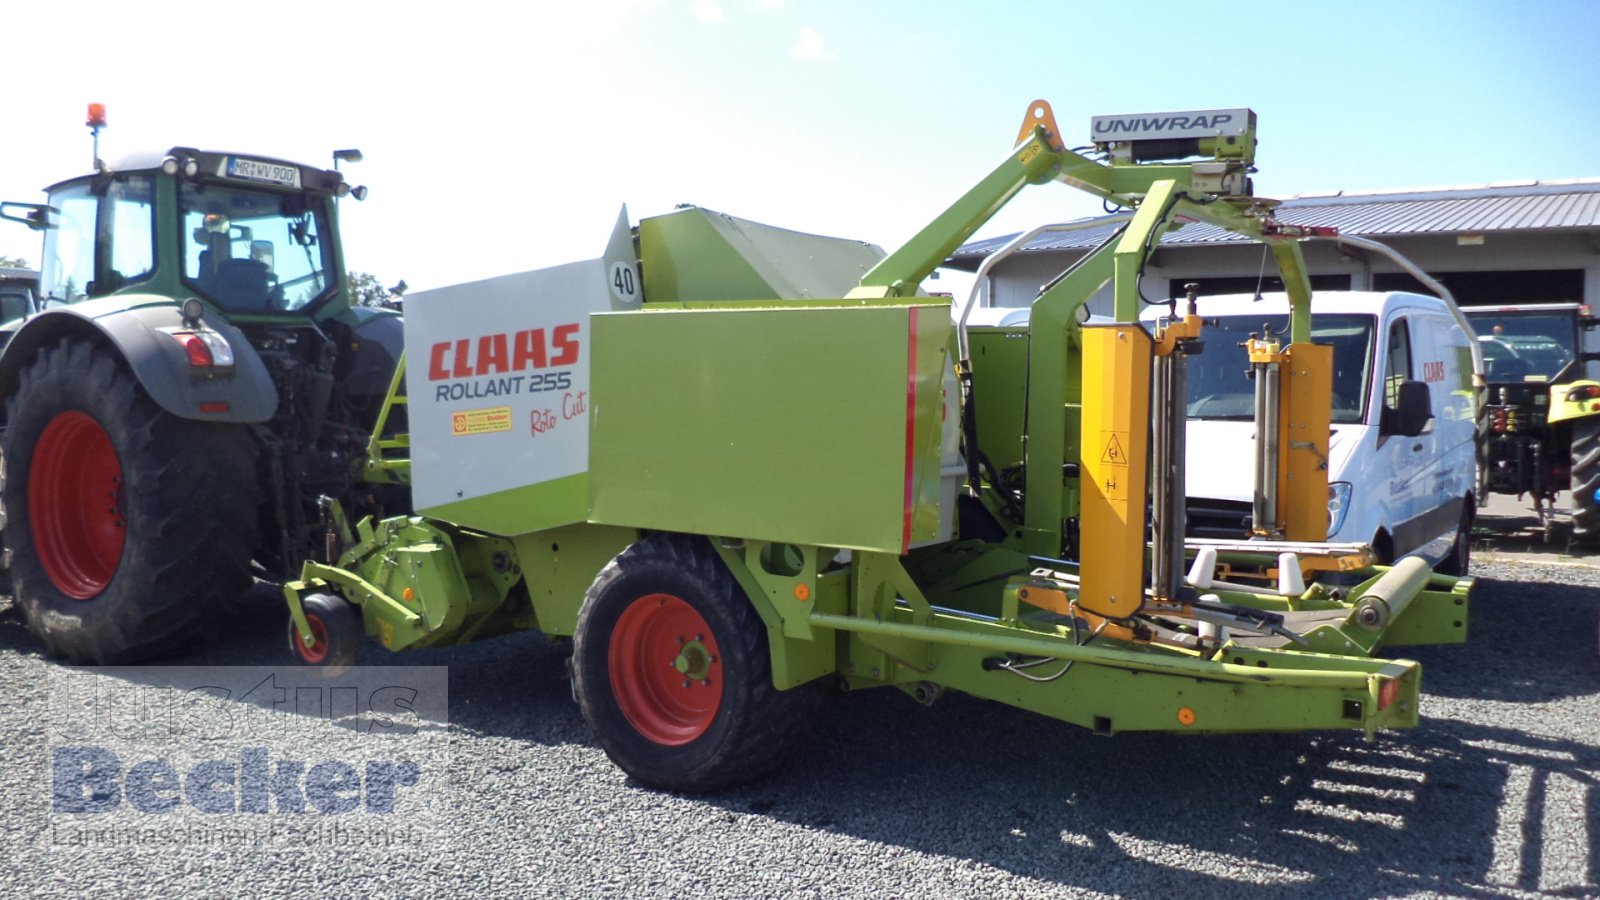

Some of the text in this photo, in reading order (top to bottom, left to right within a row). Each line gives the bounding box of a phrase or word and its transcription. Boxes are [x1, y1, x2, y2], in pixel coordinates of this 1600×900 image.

[1095, 114, 1232, 133] UNIWRAP
[273, 167, 293, 181] 900
[614, 266, 635, 295] 40
[428, 323, 580, 381] CLAAS
[435, 371, 571, 402] ROLLANT 255
[1423, 361, 1444, 383] CLAAS
[530, 391, 587, 437] Roto Cut
